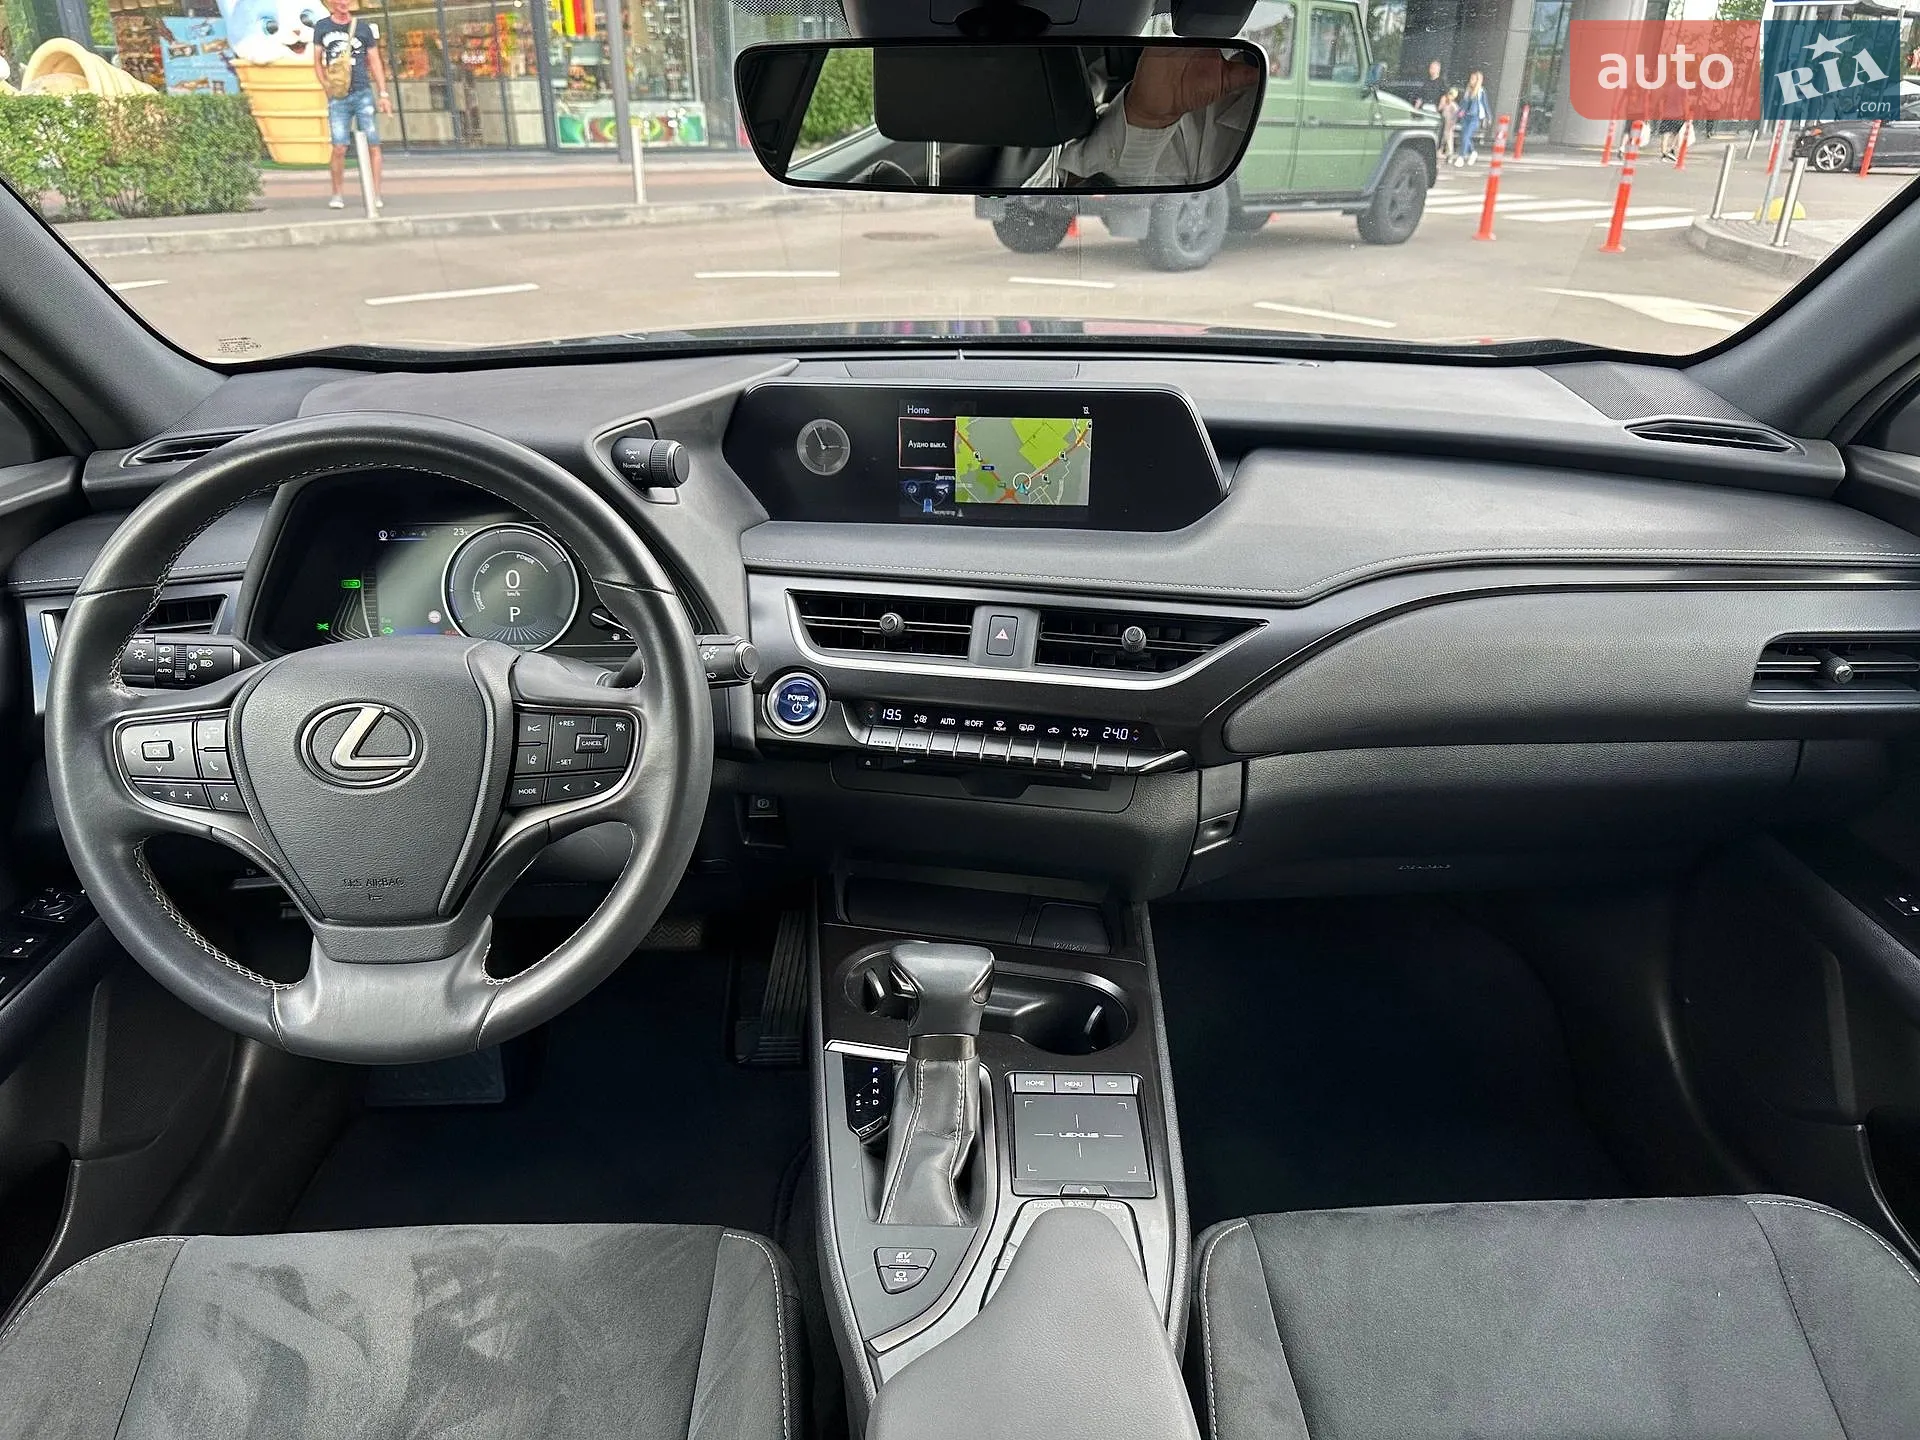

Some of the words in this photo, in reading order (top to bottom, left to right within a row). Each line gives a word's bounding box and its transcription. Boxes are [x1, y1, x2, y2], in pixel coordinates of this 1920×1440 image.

[907, 405, 930, 414] Home
[908, 440, 929, 449] Аудио
[509, 606, 521, 622] P
[787, 694, 810, 702] POWER
[881, 708, 902, 721] 19.5
[940, 717, 956, 726] AUTO
[970, 719, 984, 728] OFF
